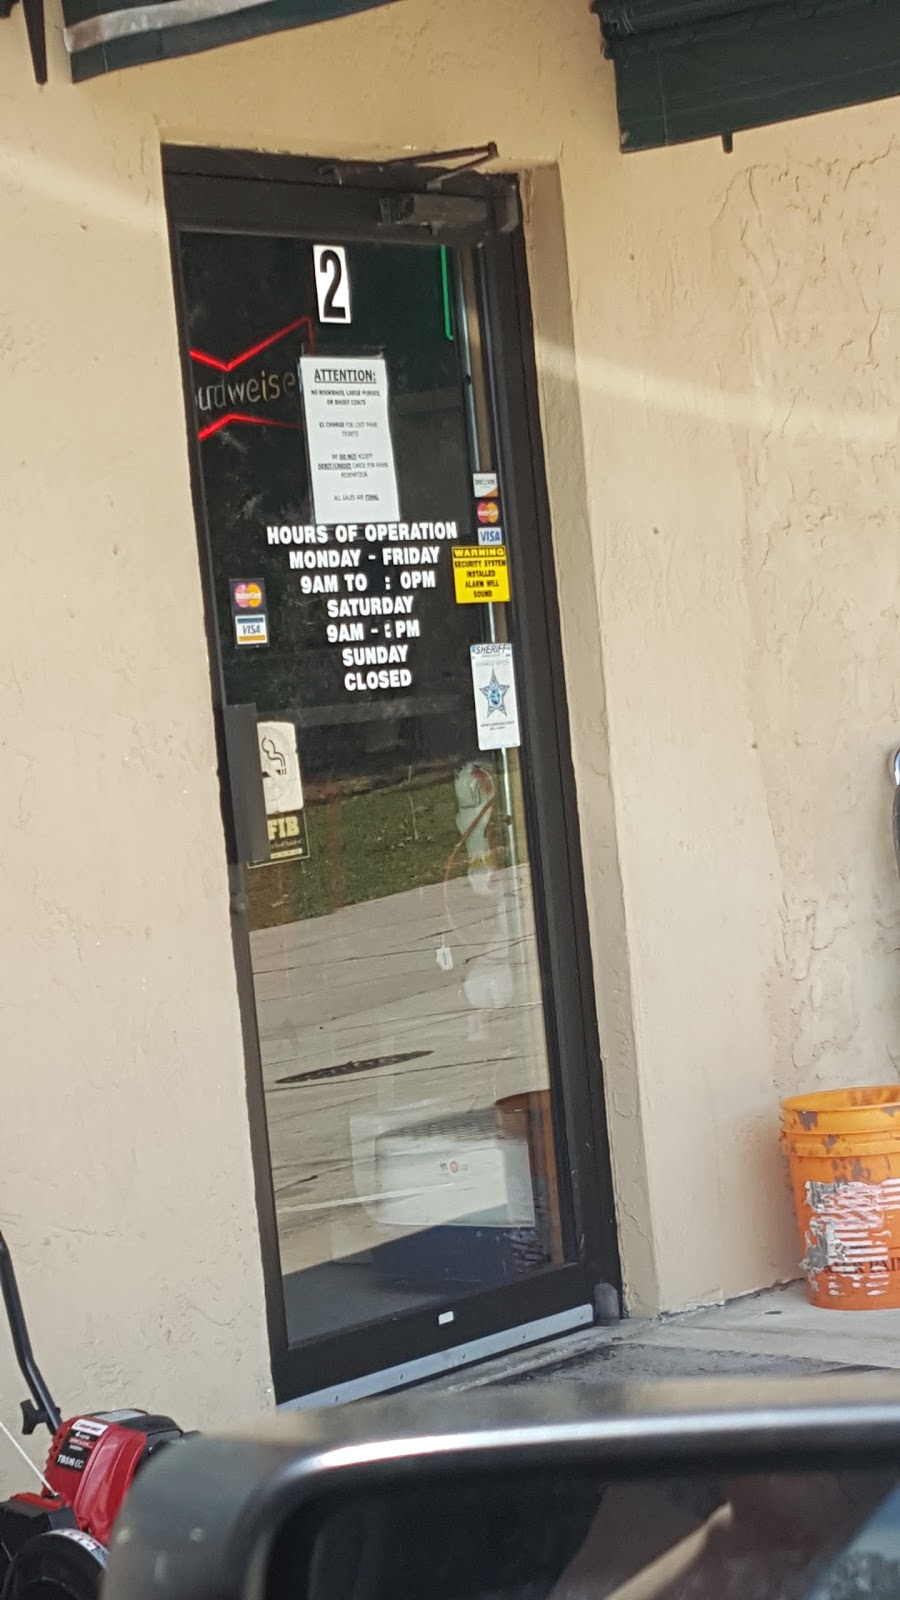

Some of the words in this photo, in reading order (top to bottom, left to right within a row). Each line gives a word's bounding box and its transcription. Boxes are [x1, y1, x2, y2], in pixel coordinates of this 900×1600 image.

[320, 249, 346, 318] 2
[314, 368, 376, 384] ATTENTION:
[194, 370, 296, 411] udweise
[267, 525, 328, 545] HOURS
[335, 525, 357, 543] OF
[365, 522, 457, 542] OPERATION
[480, 531, 500, 542] VISA
[289, 549, 361, 569] MONDAY
[382, 546, 440, 565] FRIDAY
[454, 548, 504, 558] WARNING
[301, 575, 339, 594] 9AM
[344, 574, 367, 591] TO
[467, 570, 495, 578] INSTALLED
[327, 596, 414, 618] SATURDAY
[242, 625, 261, 634] VISA
[327, 623, 364, 643] 9AM
[342, 645, 408, 667] SUNDAY
[476, 644, 508, 655] SHERIFF
[345, 669, 412, 691] CLOSED
[267, 816, 300, 840] FIB
